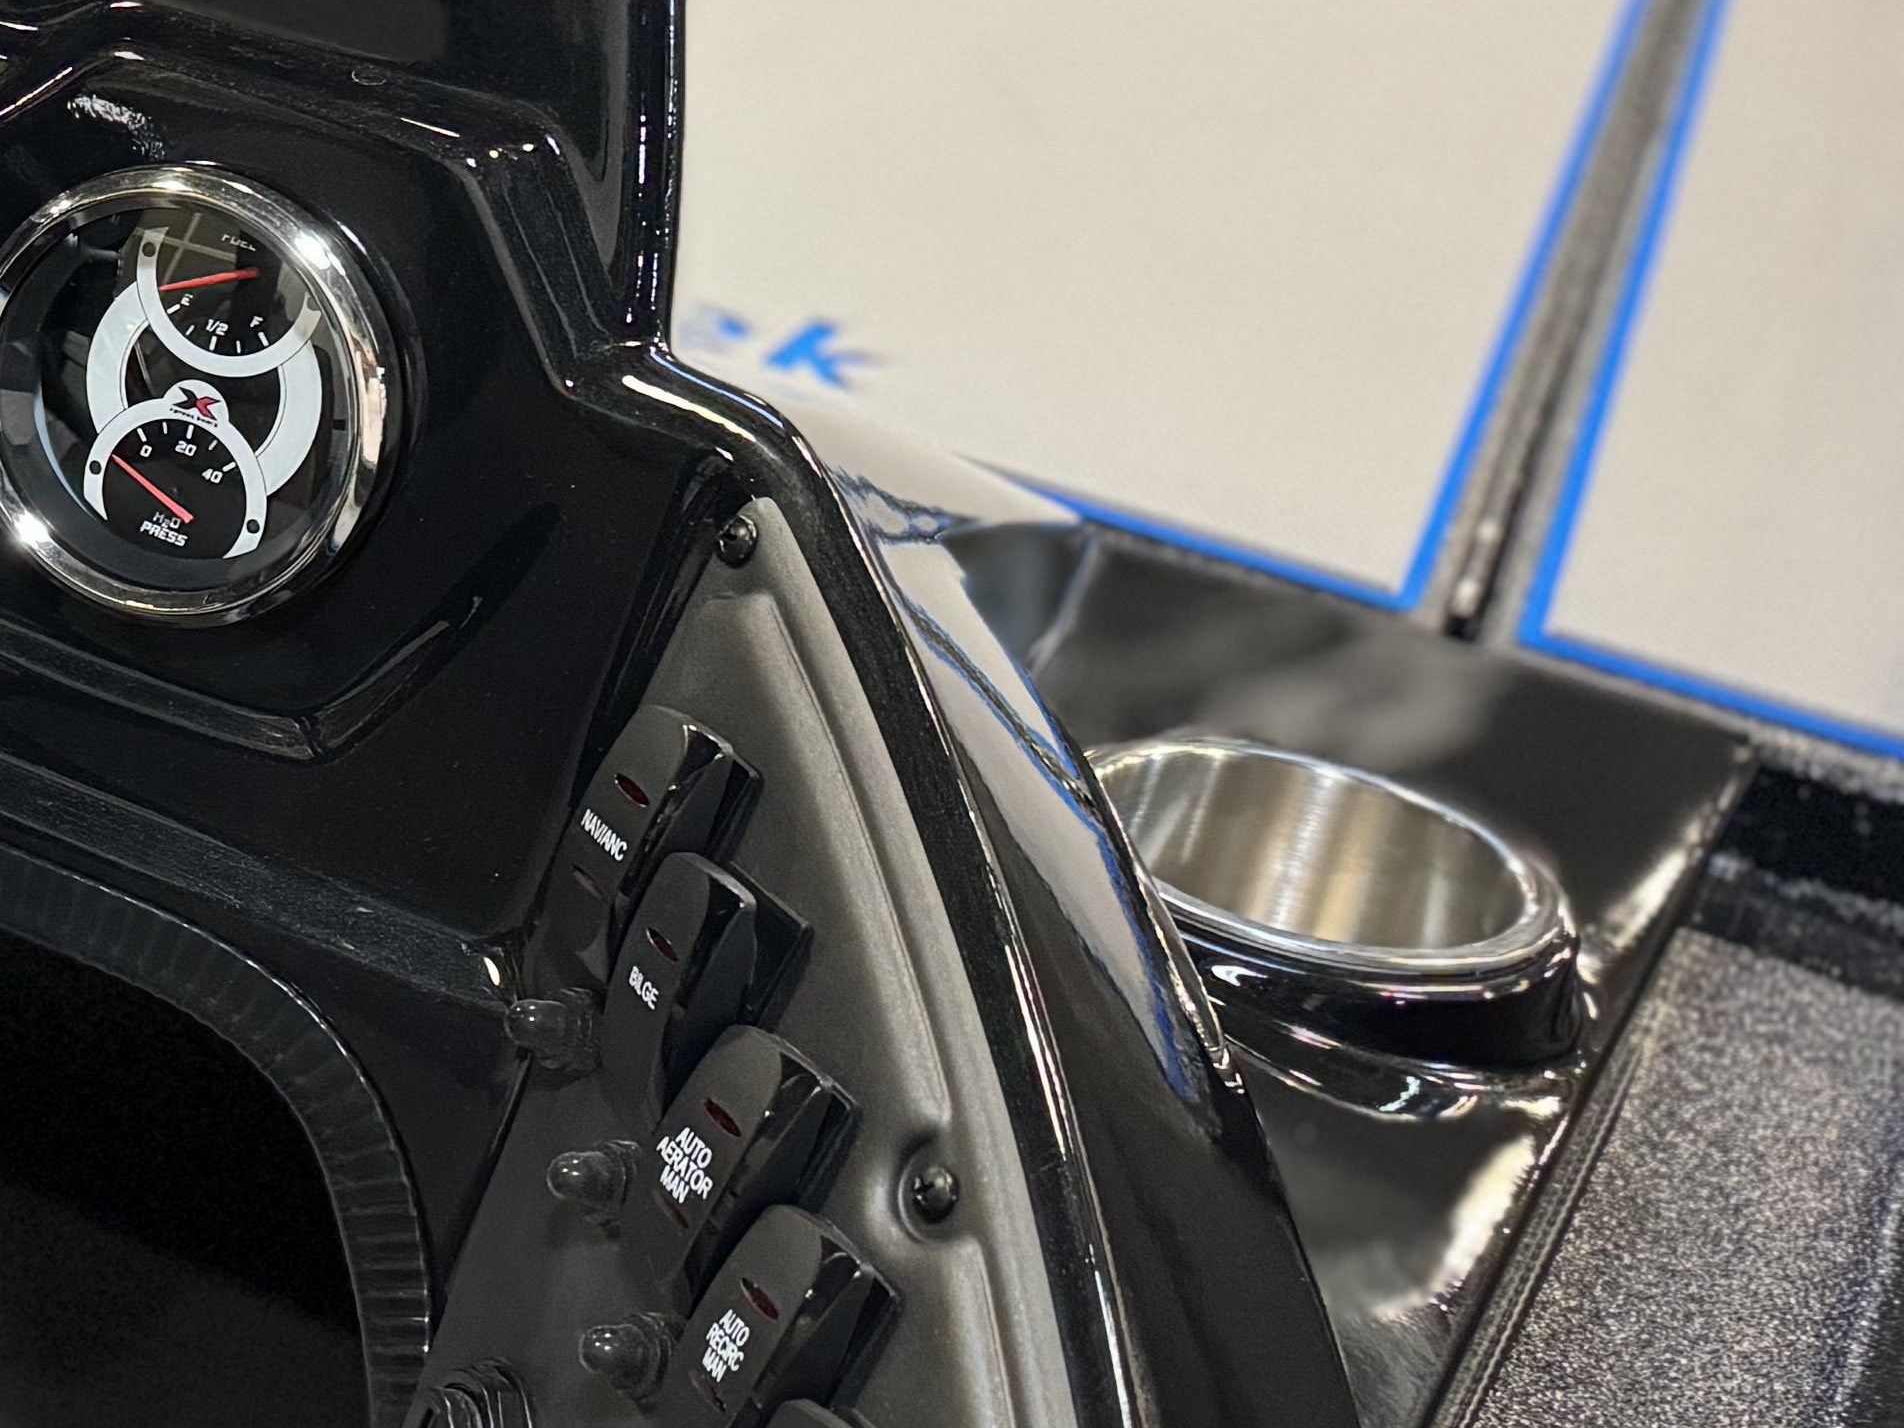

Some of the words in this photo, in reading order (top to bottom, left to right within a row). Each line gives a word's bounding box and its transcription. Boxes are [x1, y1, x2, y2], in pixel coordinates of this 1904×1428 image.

[205, 318, 229, 336] 1/2
[249, 315, 264, 328] F
[140, 445, 153, 458] 0
[175, 440, 197, 457] 20
[202, 468, 224, 484] 40
[140, 520, 189, 547] PRESS
[628, 965, 660, 1010] BILGE
[675, 1127, 713, 1169] AUTO
[656, 1136, 714, 1200] AERATOR
[659, 1165, 690, 1204] MAN
[718, 1308, 750, 1347] AUTO
[702, 1346, 727, 1383] MAN
[705, 1322, 745, 1372] RECIRC
